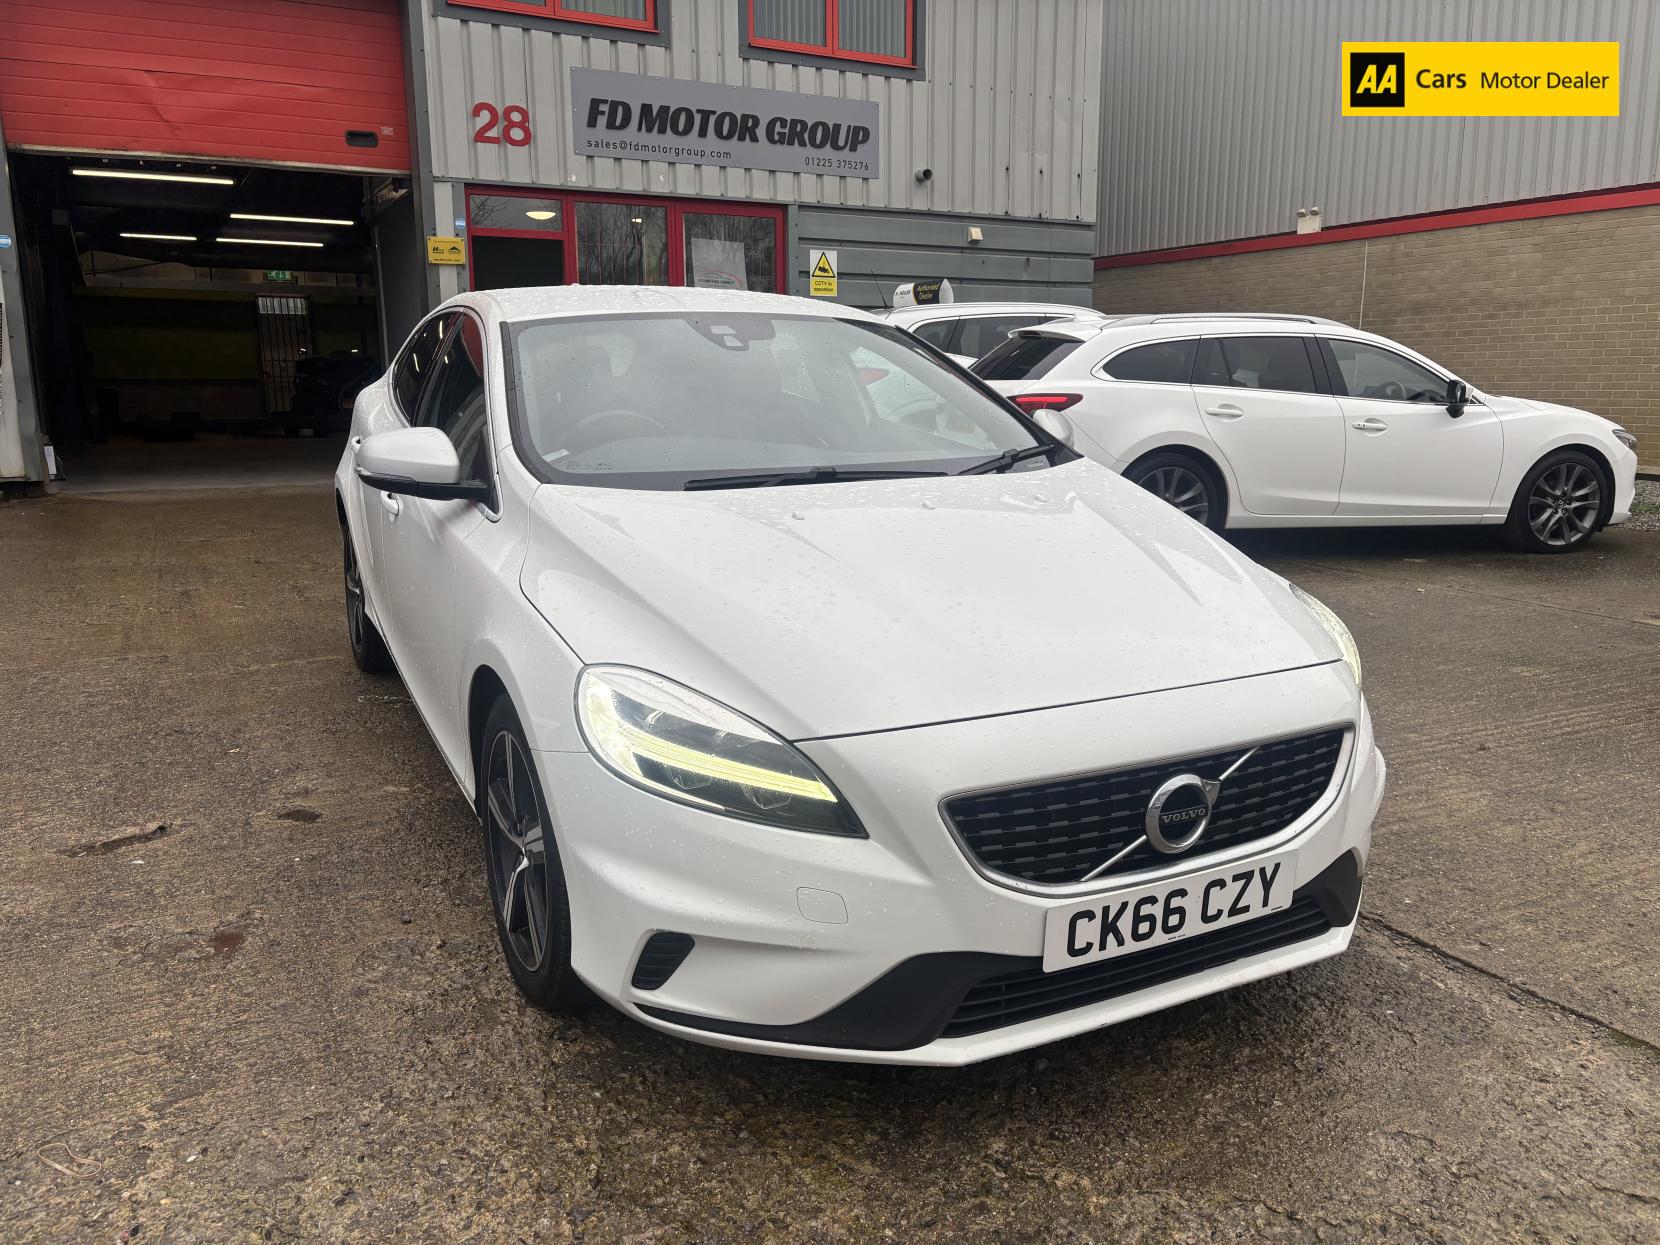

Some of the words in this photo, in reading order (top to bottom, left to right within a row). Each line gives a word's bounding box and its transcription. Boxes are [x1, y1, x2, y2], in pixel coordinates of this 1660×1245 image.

[472, 102, 532, 147] 28
[586, 97, 632, 131] FD
[637, 103, 760, 143] MOTOR
[765, 116, 871, 153] GROUP
[586, 138, 732, 160] sales@fdmotorgroup.com
[804, 155, 833, 169] 01225
[836, 158, 870, 172] 375276
[1161, 808, 1206, 824] VOLVO
[1067, 888, 1189, 958] CK66
[1200, 862, 1281, 925] CZY
